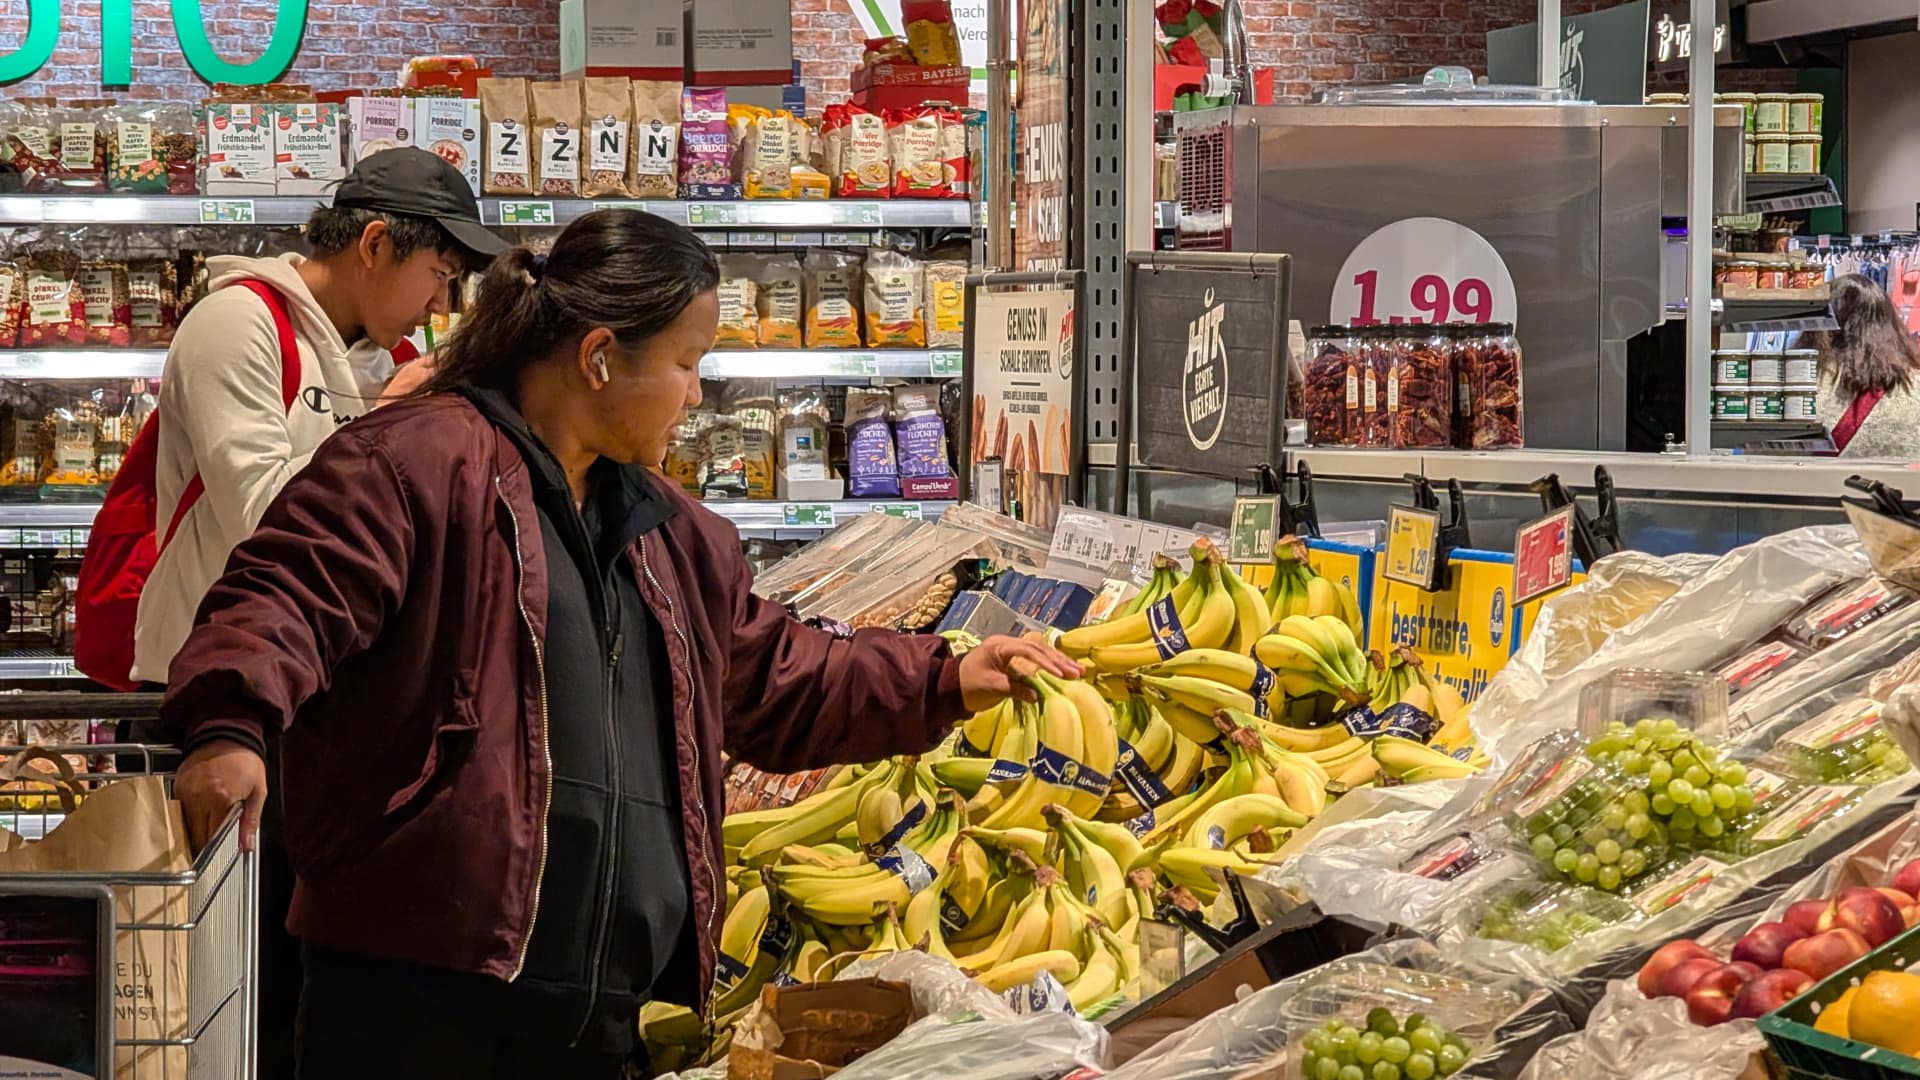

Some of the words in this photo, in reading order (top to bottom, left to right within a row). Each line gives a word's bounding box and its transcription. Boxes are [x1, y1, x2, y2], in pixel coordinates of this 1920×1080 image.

[954, 4, 985, 18] nach
[365, 116, 397, 127] PORRIDGE
[431, 117, 463, 127] PORRIDGE
[222, 134, 261, 142] Erdmandel
[288, 134, 328, 142] Erdmandel
[501, 133, 519, 156] Z
[600, 131, 620, 154] N
[648, 134, 667, 158] N
[906, 138, 936, 147] Porridge
[551, 138, 571, 162] Z
[1350, 270, 1493, 325] 1.99
[1007, 307, 1037, 341] GENUSS
[1040, 307, 1047, 341] IN
[1188, 303, 1225, 374] HIT
[1000, 349, 1021, 373] SCHALE
[1195, 365, 1214, 394] ECHTE
[907, 431, 937, 439] FLOCKEN
[1254, 530, 1270, 554] 1.99
[1409, 547, 1427, 575] 1.29
[1549, 552, 1564, 585] 1.99
[1392, 601, 1424, 647] best
[1429, 605, 1471, 661] taste,
[115, 984, 153, 999] AGEN
[115, 1005, 157, 1021] NNST
